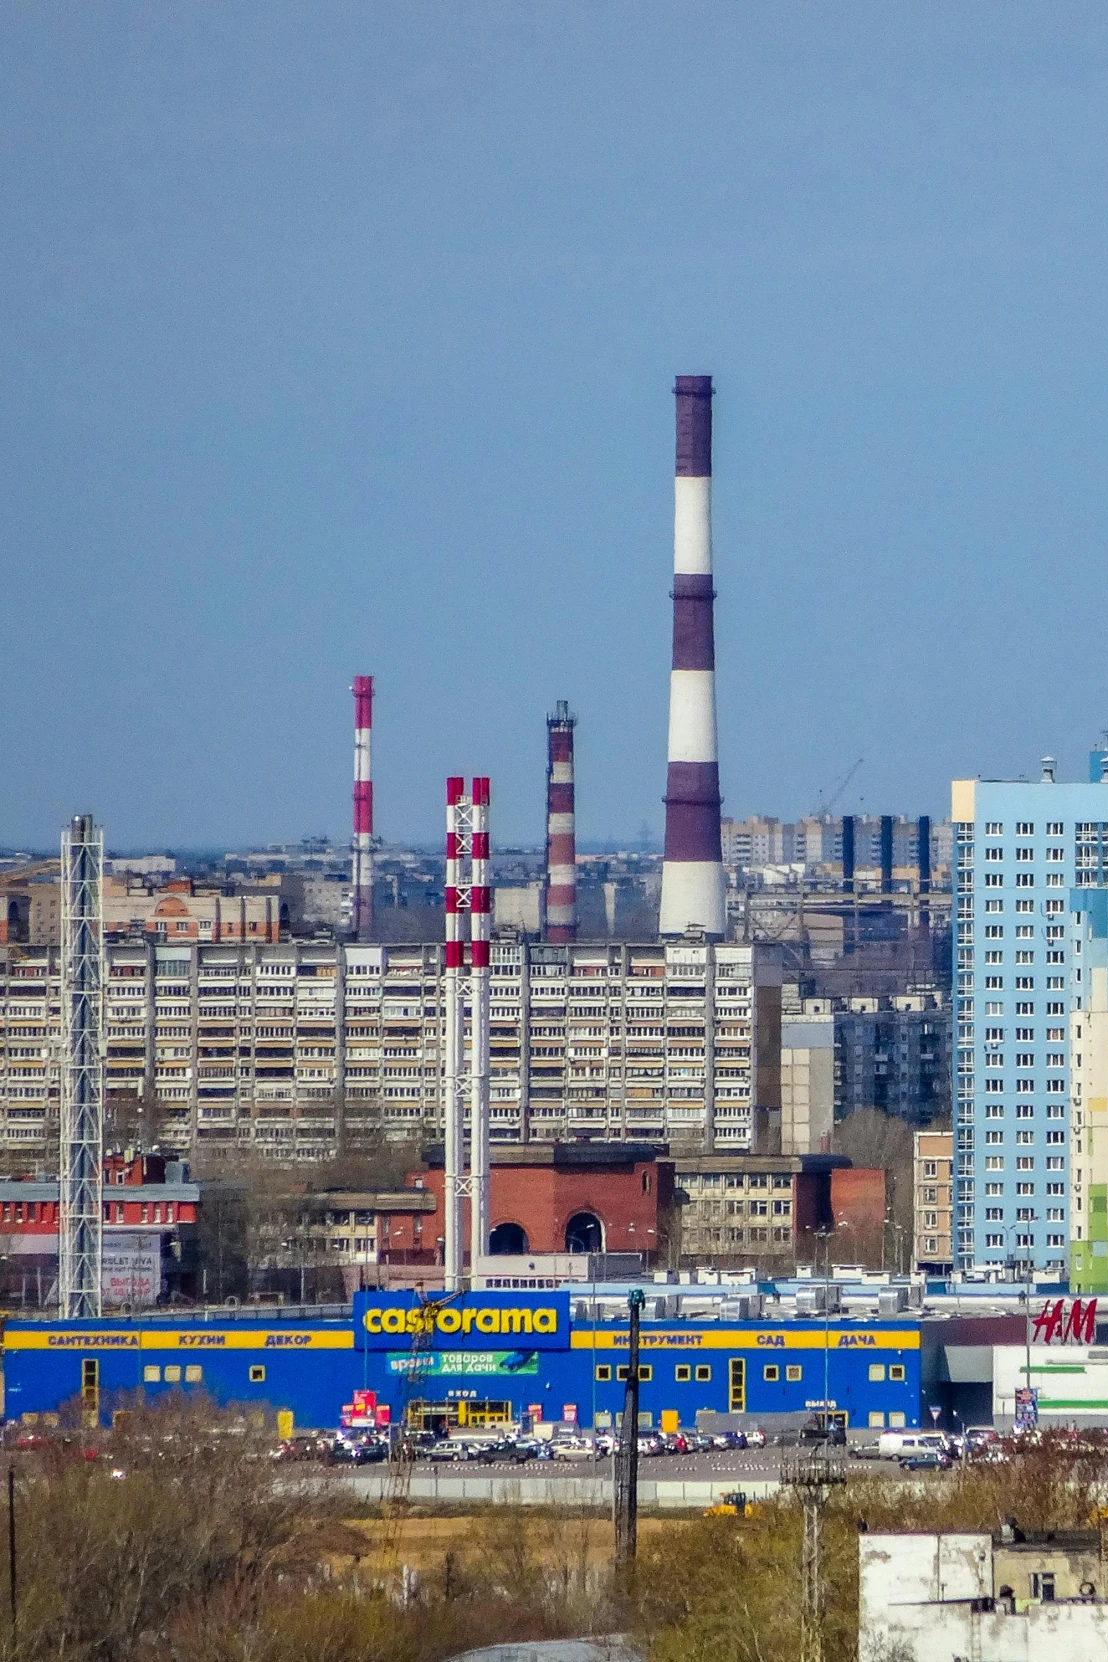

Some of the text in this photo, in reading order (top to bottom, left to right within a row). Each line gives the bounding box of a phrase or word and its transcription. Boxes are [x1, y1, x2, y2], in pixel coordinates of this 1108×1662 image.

[365, 1309, 557, 1333] castorama
[1032, 1298, 1097, 1343] H&M
[48, 1335, 312, 1347] САНТЕХНИКА КУХНИ ДЕКОР
[613, 1335, 877, 1347] ИНТРУМЕНТ САД ДАЧА
